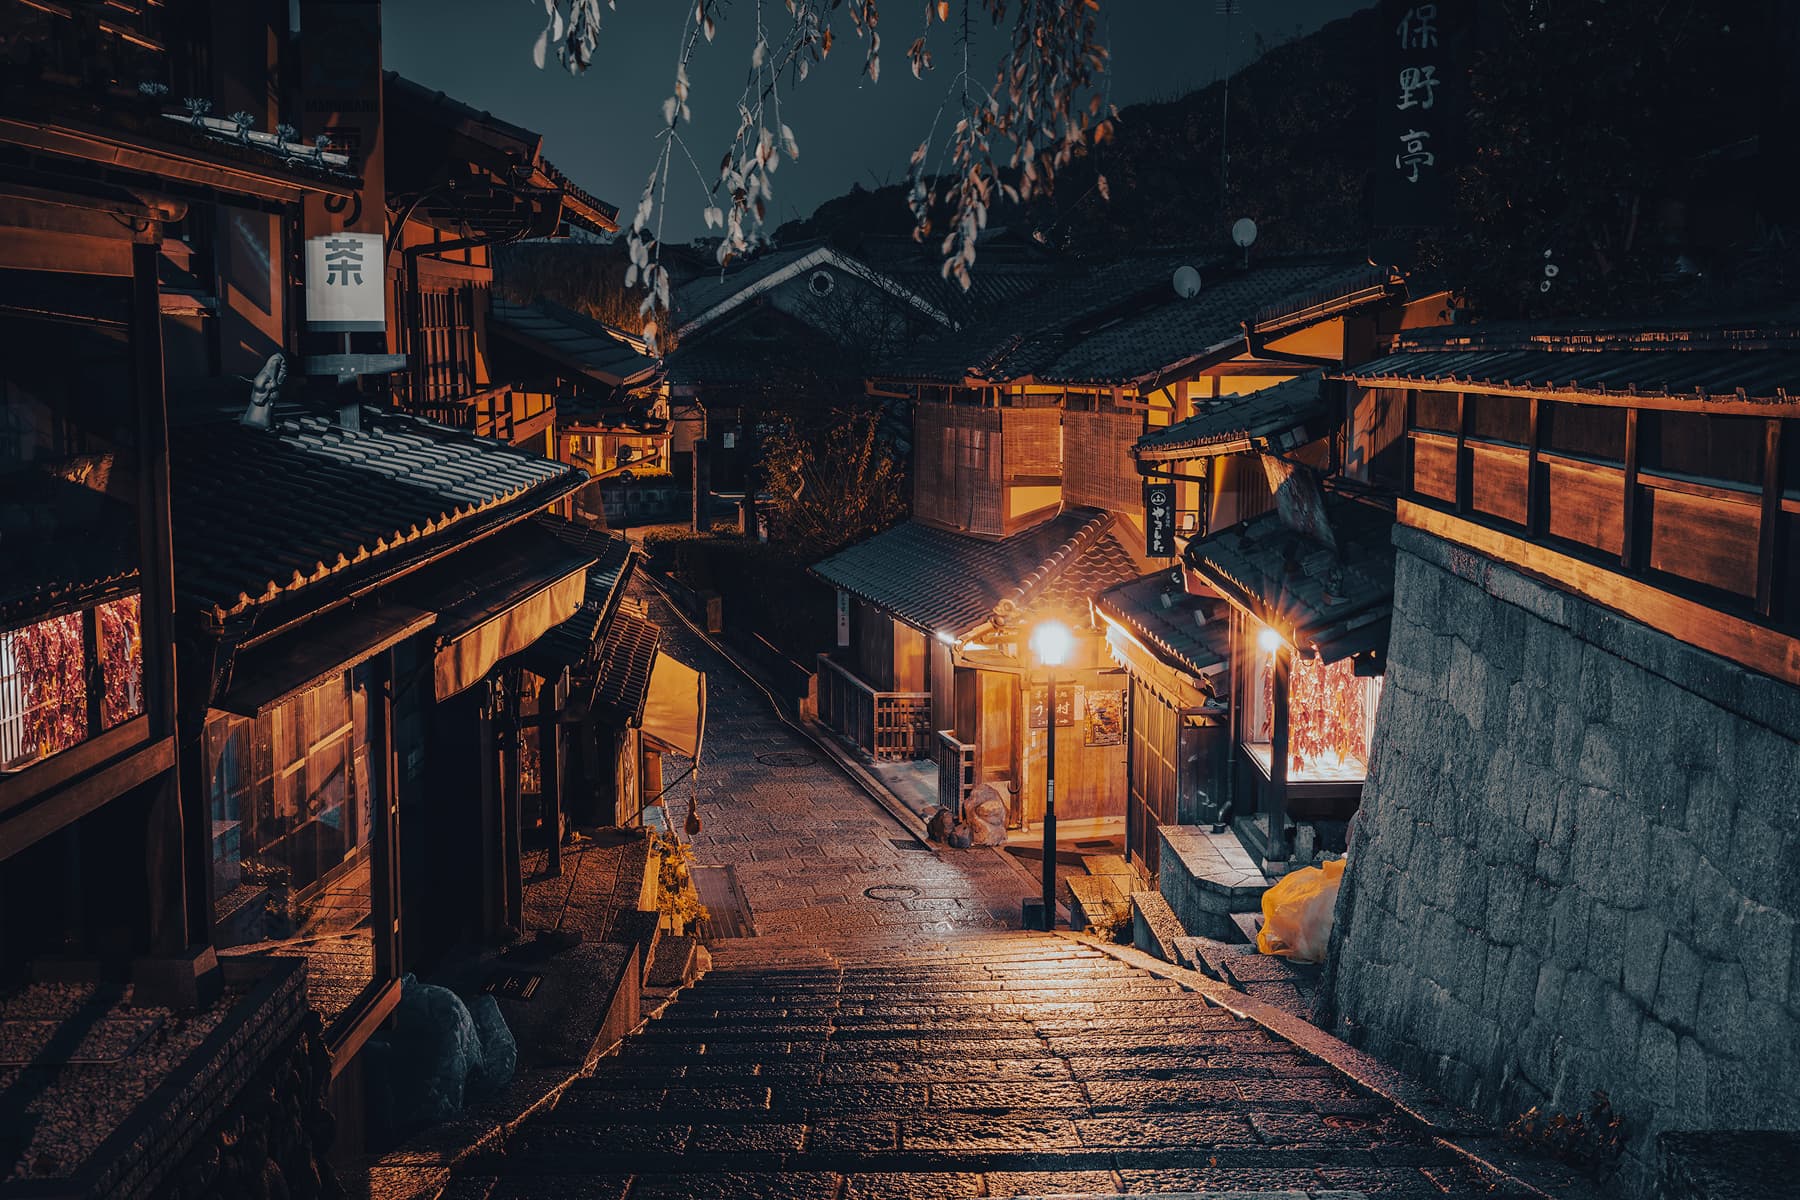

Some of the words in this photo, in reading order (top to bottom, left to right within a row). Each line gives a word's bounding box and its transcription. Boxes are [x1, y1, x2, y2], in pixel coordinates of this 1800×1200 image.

[1395, 3, 1441, 183] 保野亭
[1034, 701, 1071, 717] う村
